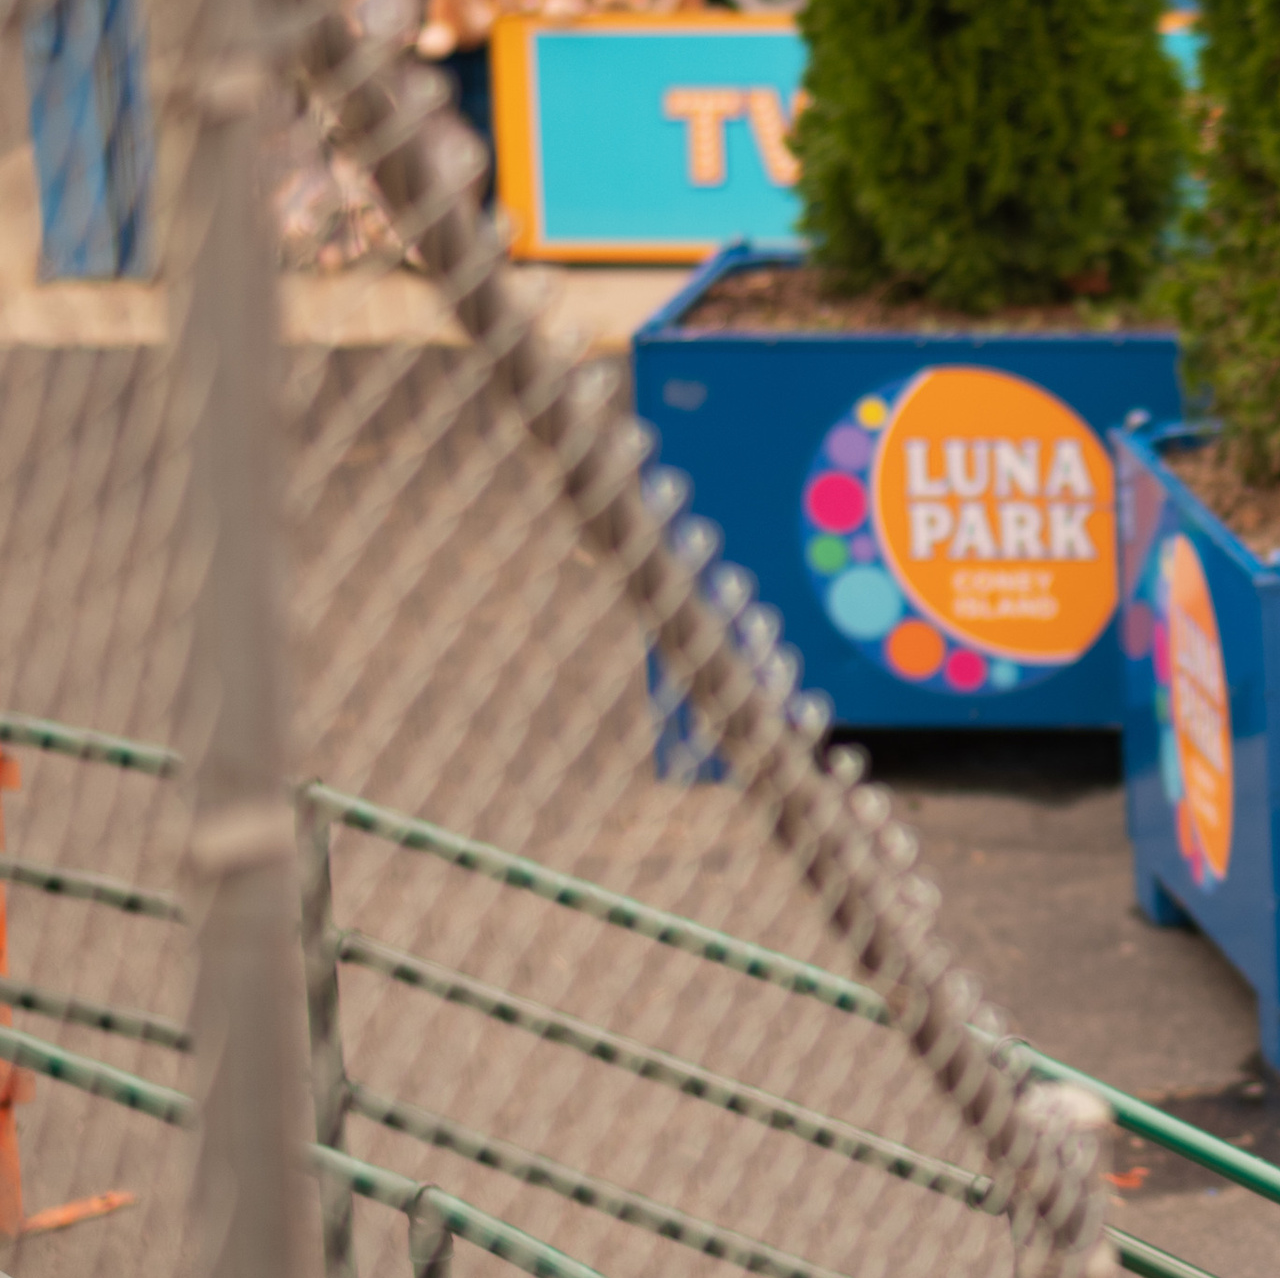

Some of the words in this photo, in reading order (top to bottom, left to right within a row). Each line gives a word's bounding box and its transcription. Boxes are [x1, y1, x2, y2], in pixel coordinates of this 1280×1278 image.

[905, 437, 1095, 498] LUNA
[910, 501, 1099, 562] PARK
[951, 569, 1055, 594] CONEY
